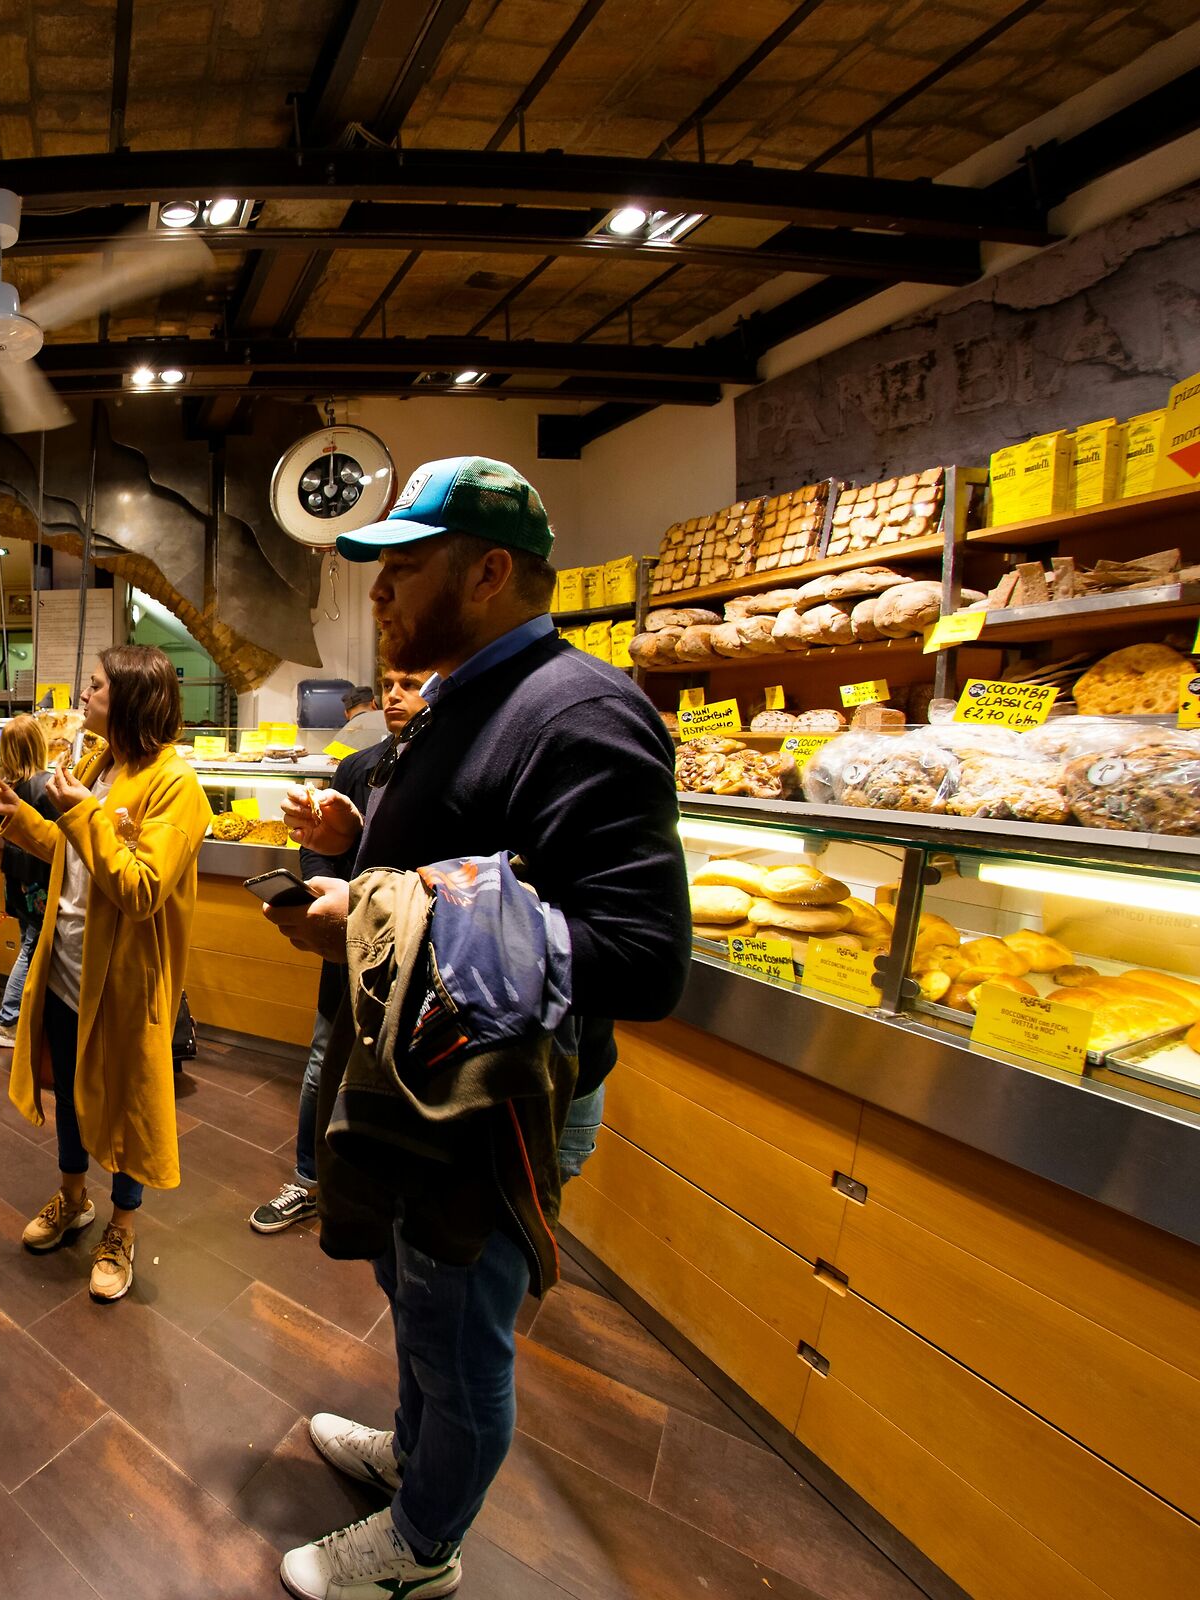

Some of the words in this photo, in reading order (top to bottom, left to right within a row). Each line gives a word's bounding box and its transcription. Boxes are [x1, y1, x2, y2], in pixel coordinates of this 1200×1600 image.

[987, 684, 1049, 699] COLOMBA
[976, 697, 1042, 712] CLASSICA
[693, 708, 733, 724] COLOMBINA
[745, 939, 767, 951] PANE
[1000, 1008, 1038, 1024] BOCCONCINI
[1011, 1019, 1034, 1030] UVETTA
